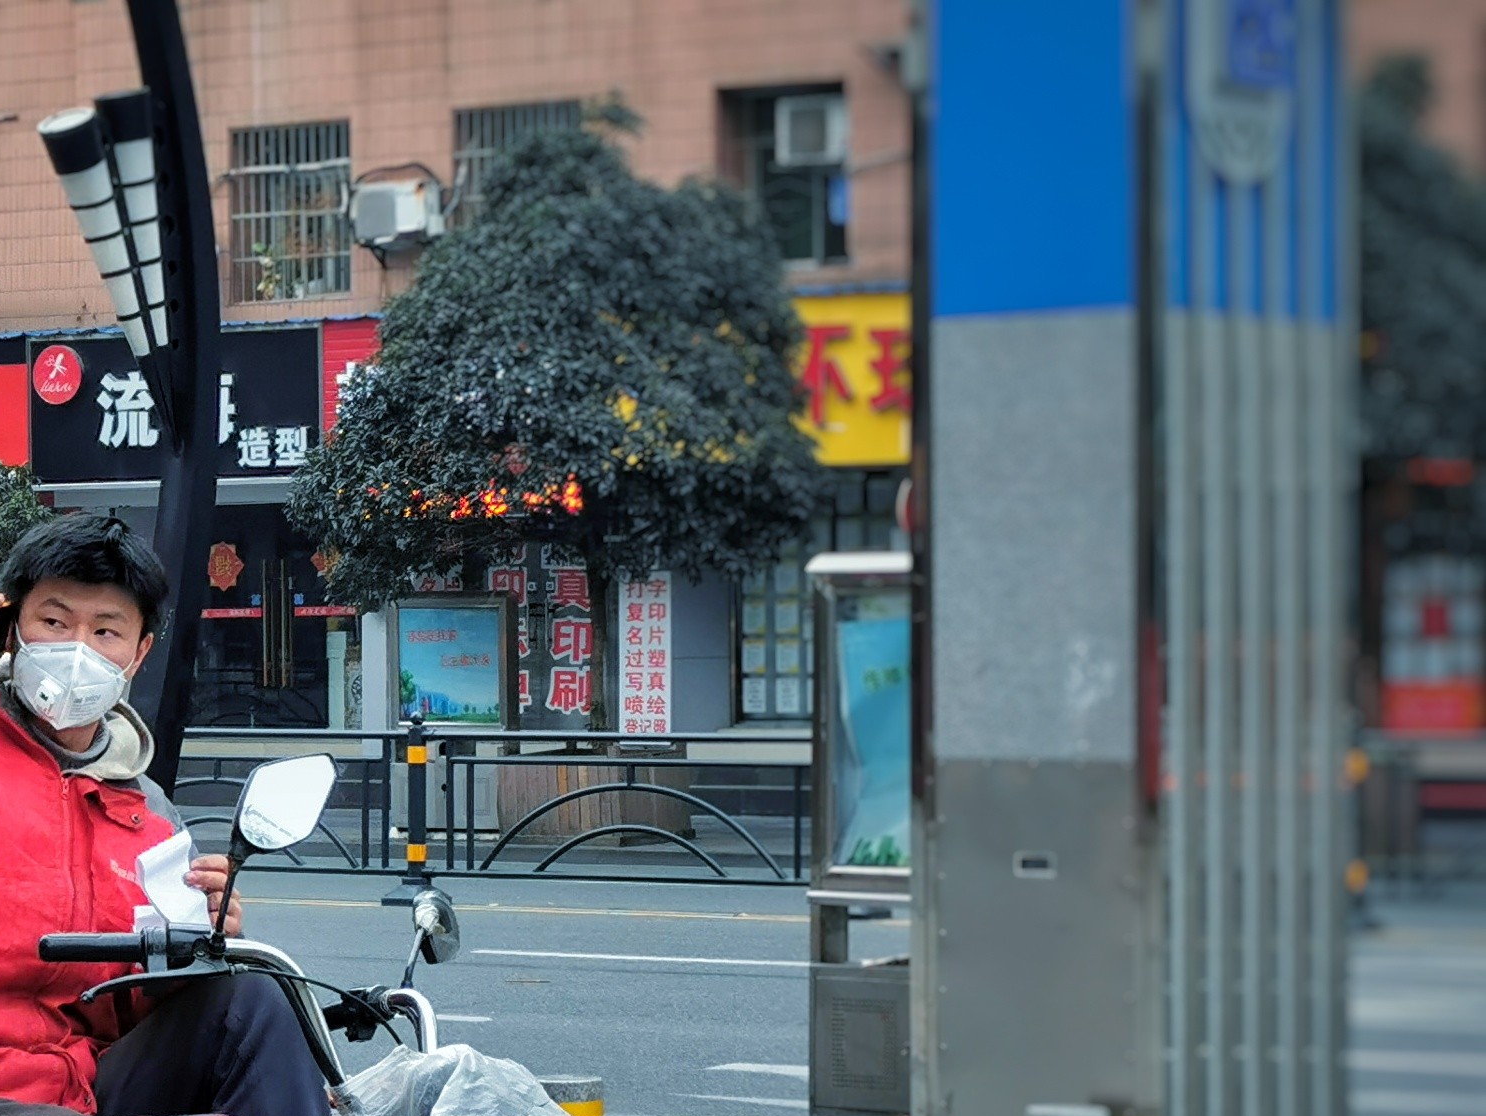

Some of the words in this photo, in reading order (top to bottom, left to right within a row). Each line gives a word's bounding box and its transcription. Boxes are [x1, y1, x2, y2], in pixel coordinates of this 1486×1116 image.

[96, 371, 238, 448] 流
[238, 426, 309, 467] 造型
[626, 578, 667, 598] 打字
[626, 603, 667, 622] 复印
[541, 545, 594, 716] 真印刷
[626, 626, 665, 646] 名片
[625, 650, 667, 669] 过塑
[625, 672, 666, 691] 写真
[625, 696, 666, 715] 喷绘
[625, 719, 667, 733] 登记照
